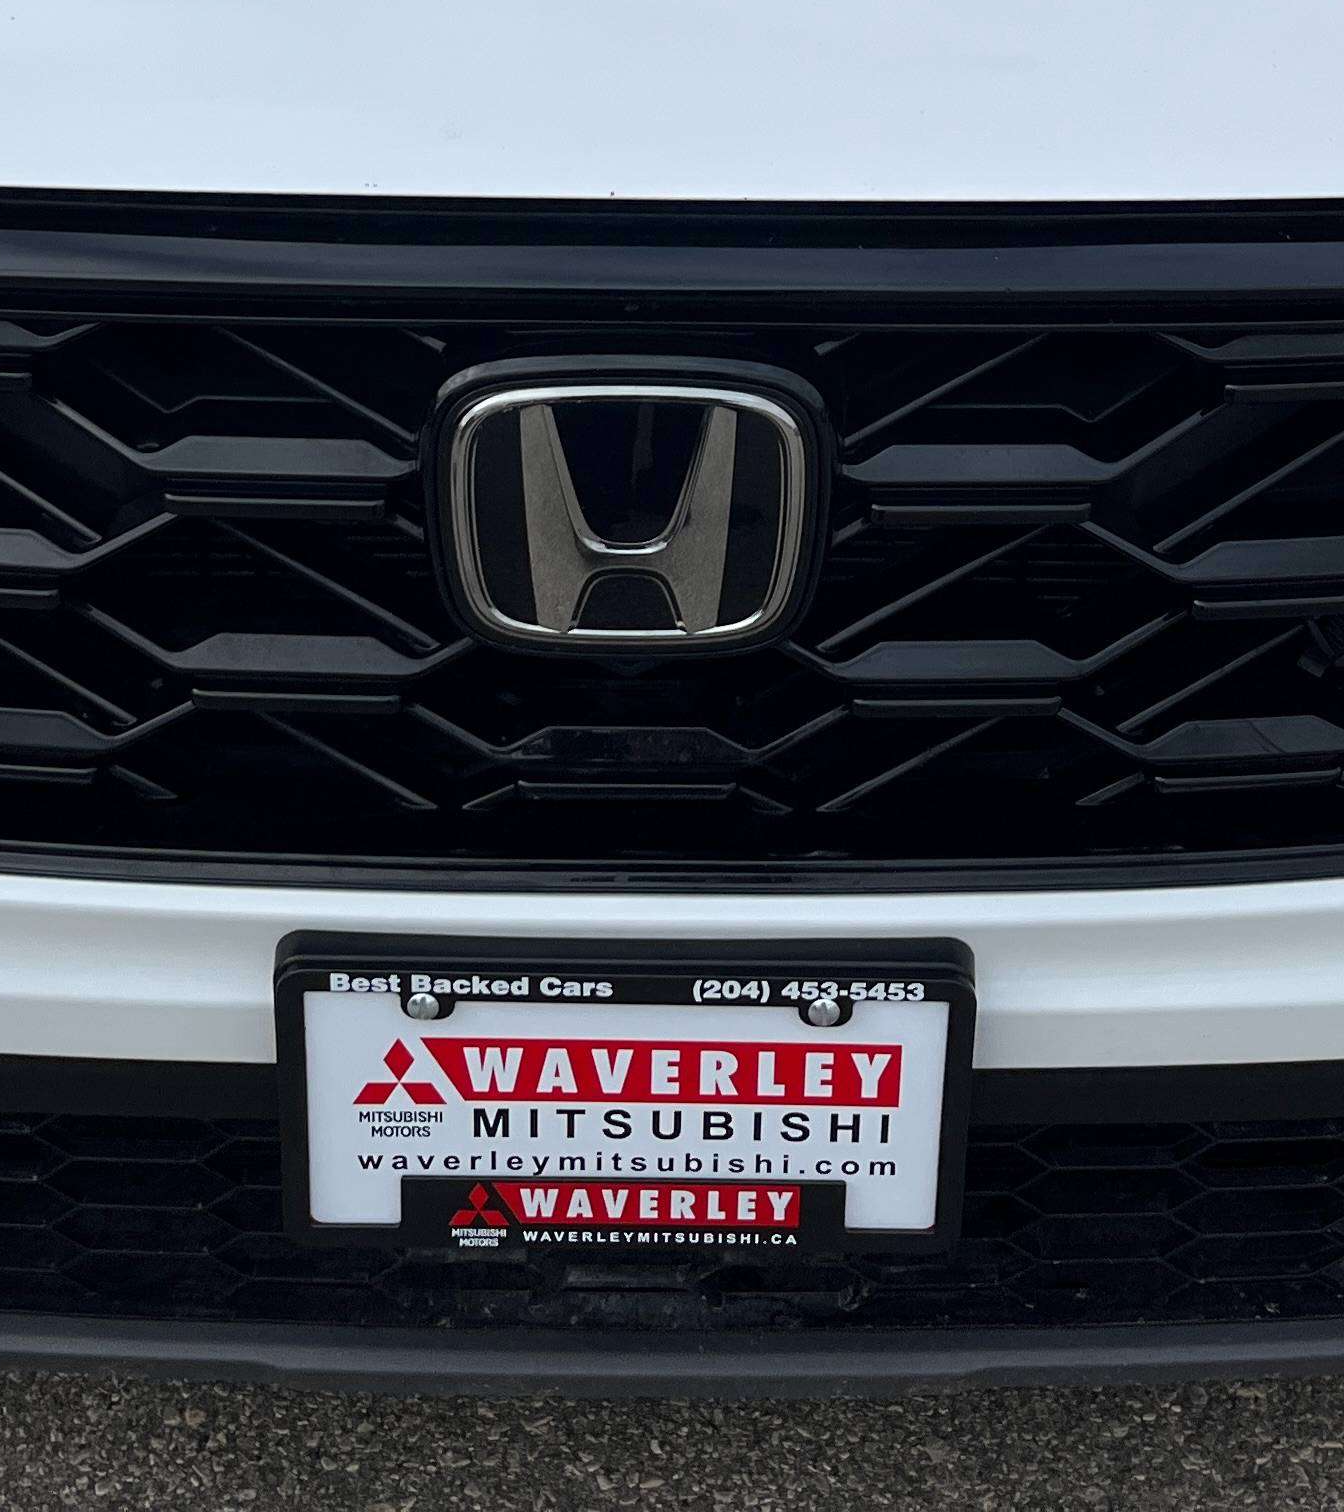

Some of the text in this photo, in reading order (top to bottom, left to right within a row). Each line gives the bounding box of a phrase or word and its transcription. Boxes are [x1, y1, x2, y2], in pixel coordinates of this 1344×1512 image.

[329, 972, 614, 997] Best Backed Cars
[692, 979, 926, 1003] (204) 453-5453
[462, 1046, 893, 1099] WAVERLEY
[358, 1110, 444, 1124] MITSUBISHI
[472, 1107, 892, 1144] MITSUBISHI
[370, 1125, 432, 1138] MOTORS
[356, 1150, 897, 1176] waverleymitsubishi.com
[519, 1187, 795, 1222] WAVERLEY
[451, 1227, 507, 1238] MITSUBISHI
[458, 1237, 500, 1248] MOTORS
[522, 1230, 798, 1246] WAVERLEYMITSUBISHI.CA
